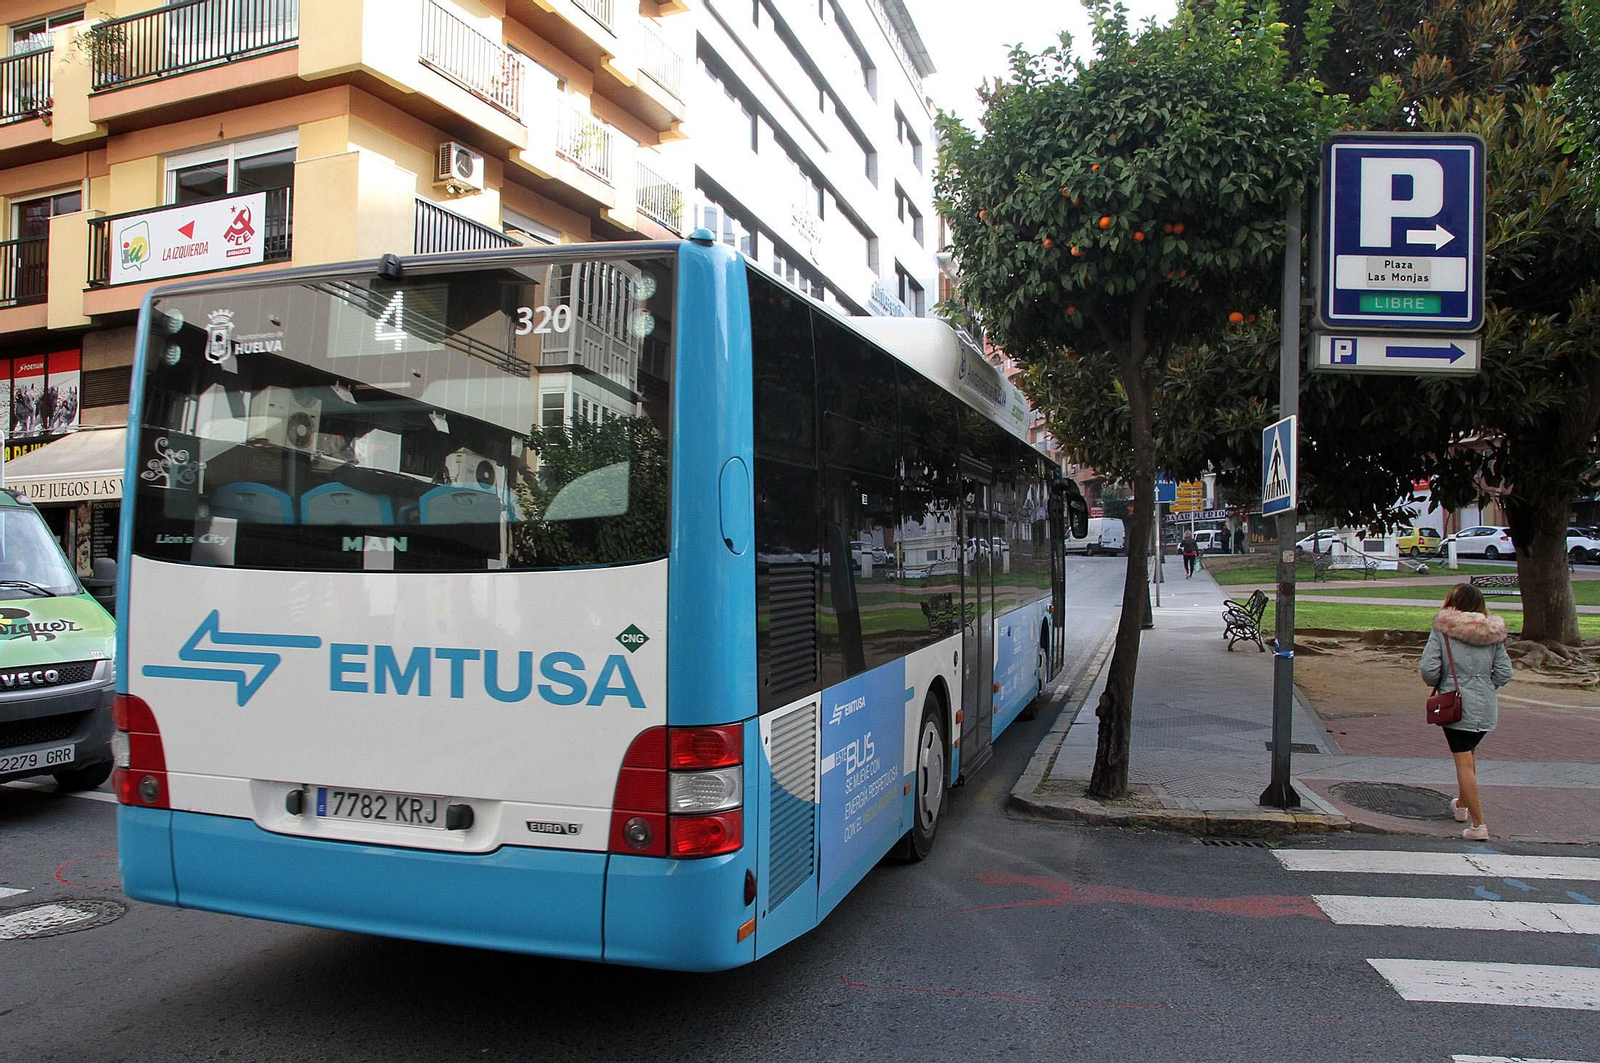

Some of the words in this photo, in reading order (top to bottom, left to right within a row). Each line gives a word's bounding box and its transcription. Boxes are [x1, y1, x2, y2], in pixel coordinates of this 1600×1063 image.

[1360, 158, 1444, 248] P
[227, 233, 250, 246] PCE
[162, 248, 171, 261] LA
[172, 241, 209, 259] IZQUIERDA
[1384, 260, 1413, 269] Plaza
[1368, 272, 1386, 281] Las
[1391, 272, 1429, 282] Monjas
[1374, 297, 1426, 310] LIBRE
[375, 290, 407, 350] 4
[515, 304, 572, 336] 320
[234, 340, 283, 355] HUELVA
[1334, 339, 1353, 363] P
[31, 483, 46, 498] DE
[49, 481, 90, 500] JUEGOS
[93, 479, 116, 495] LAS
[155, 533, 194, 544] Lion's
[199, 533, 230, 546] City
[342, 536, 408, 552] MAN
[621, 633, 644, 643] CNG
[330, 643, 647, 708] EMTUSA
[844, 696, 866, 717] EMTUSA
[1, 754, 38, 772] 2279
[46, 748, 72, 764] GRR
[835, 746, 847, 767] ESTE
[846, 731, 875, 776] BUS
[845, 776, 853, 795] SE
[853, 764, 870, 790] MUEVE
[869, 757, 880, 777] CON
[332, 791, 388, 820] 7782
[396, 797, 437, 824] KRJ
[530, 821, 562, 834] EURO
[567, 824, 578, 834] 6
[844, 822, 856, 842] CON
